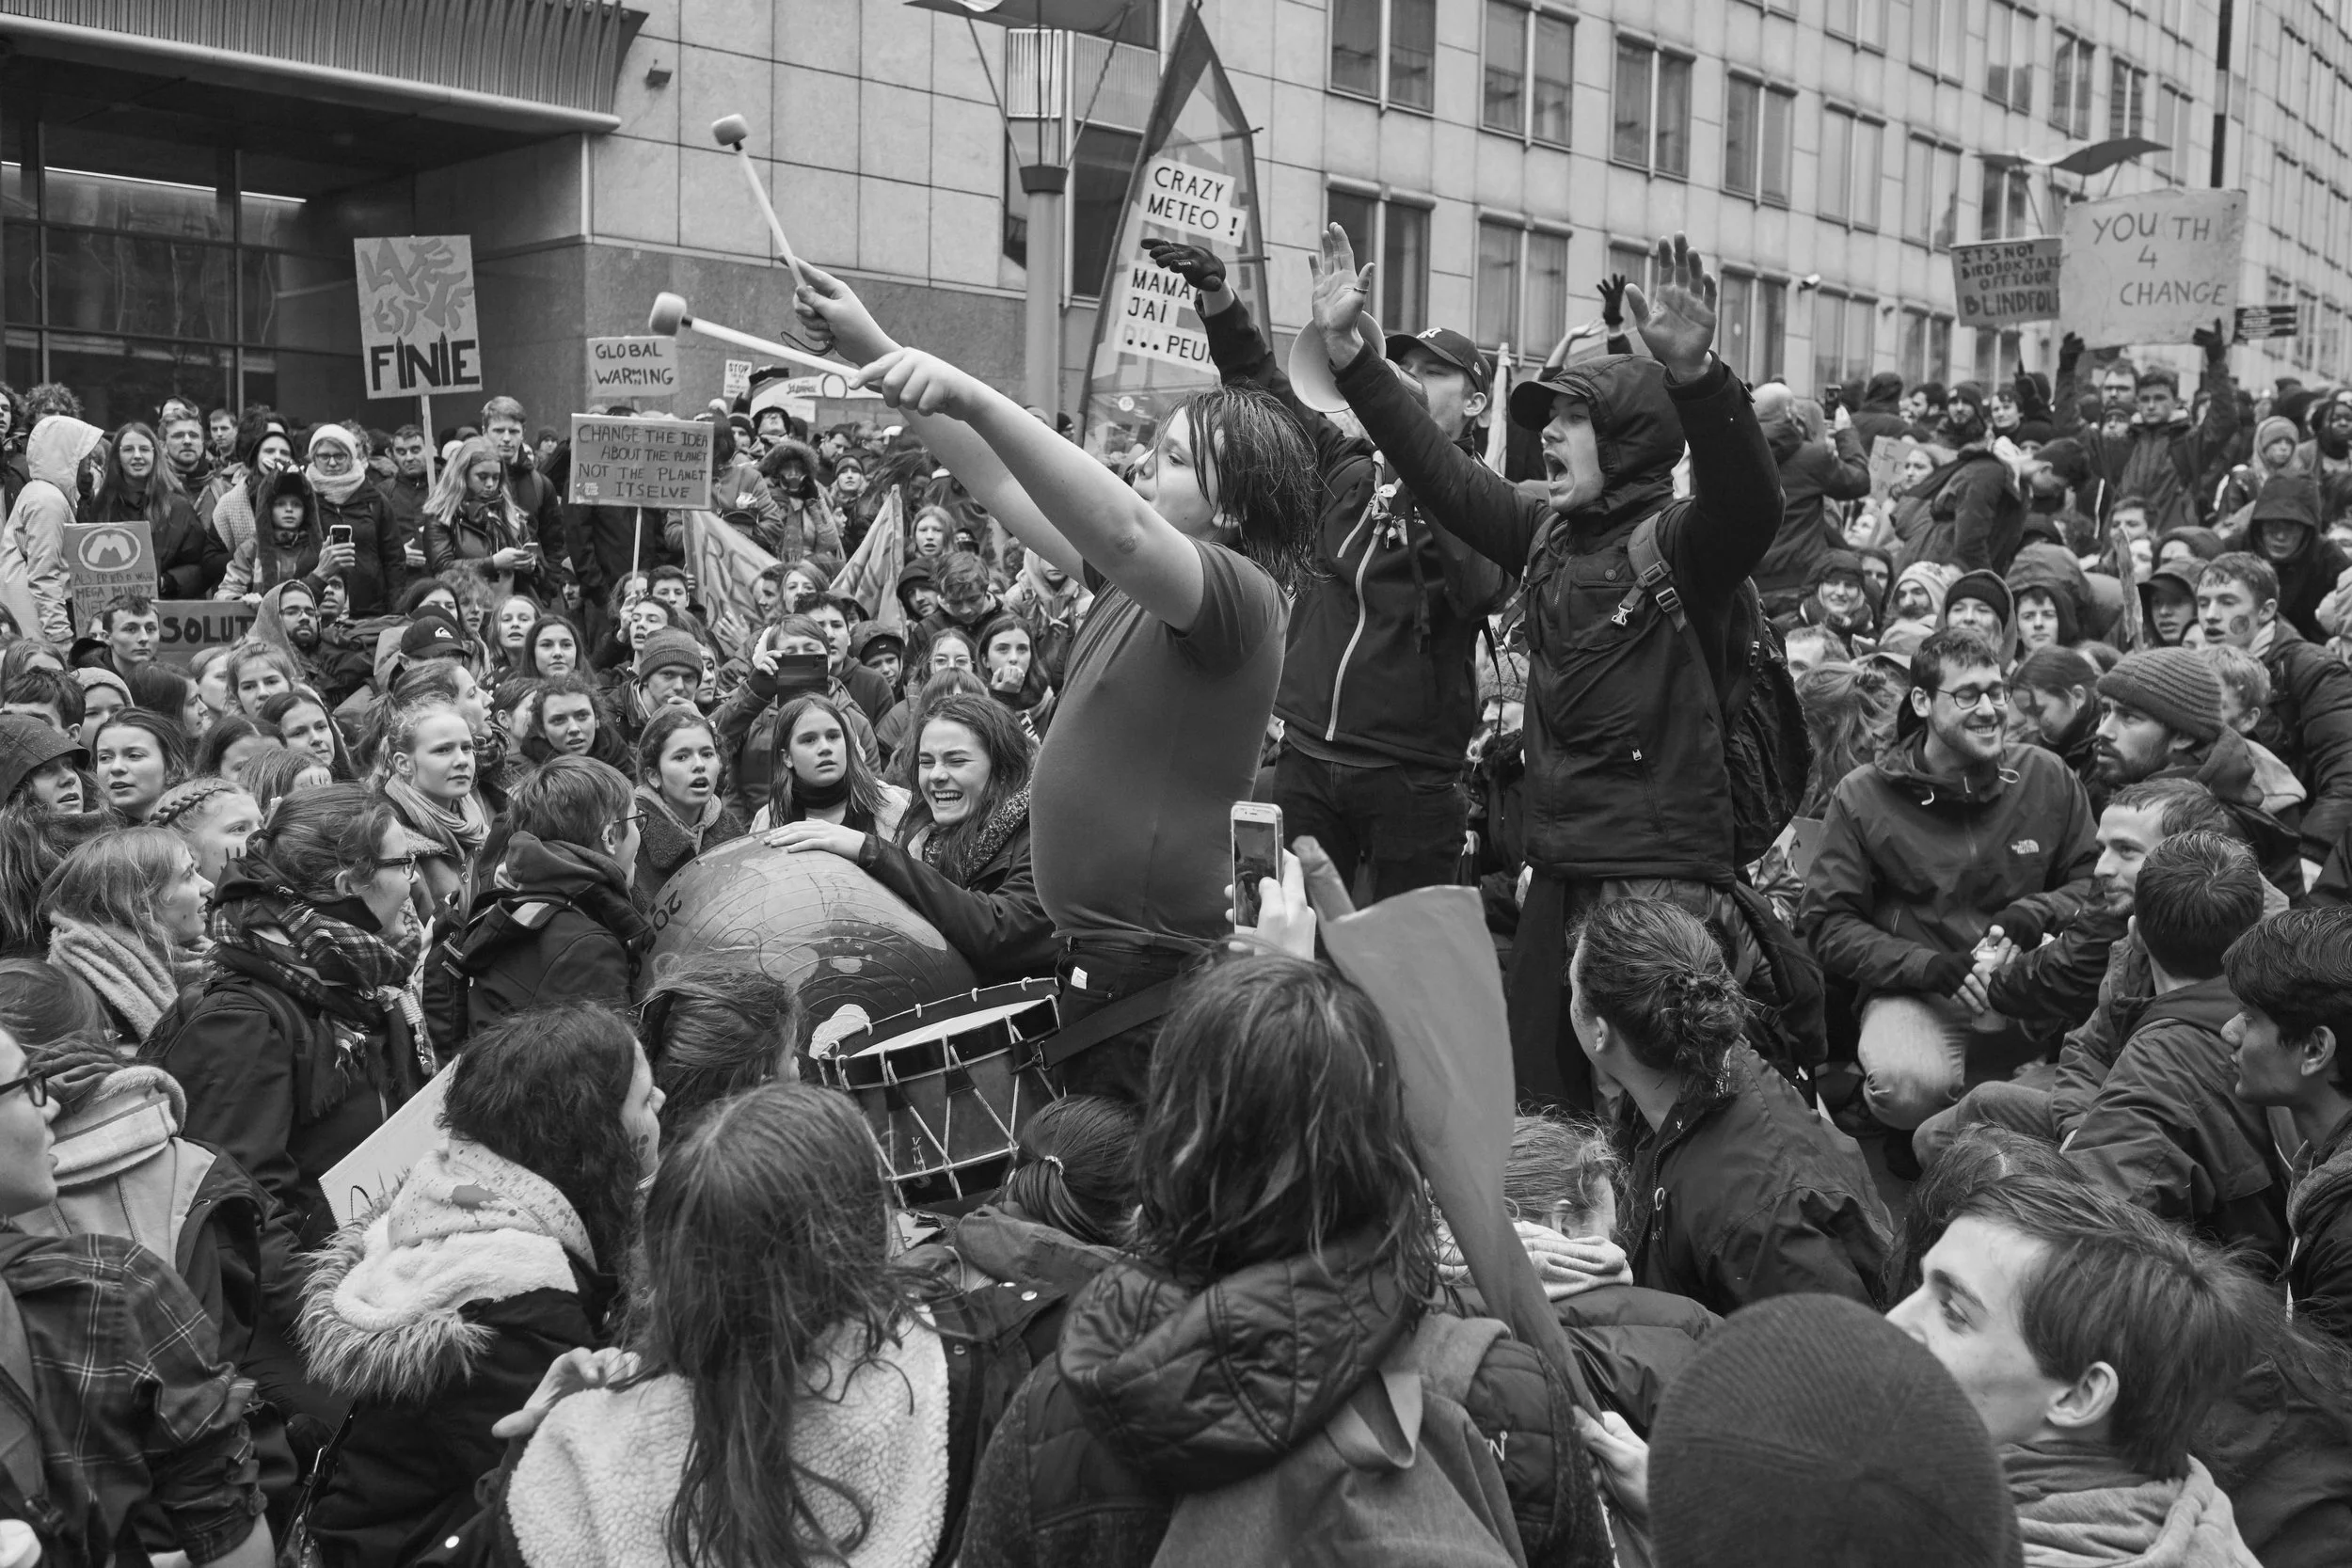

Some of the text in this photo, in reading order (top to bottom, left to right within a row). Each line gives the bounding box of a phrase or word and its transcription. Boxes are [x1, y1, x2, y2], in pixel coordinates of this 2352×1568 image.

[1154, 166, 1224, 202] CRAZY
[2004, 244, 2034, 258] NOT
[2137, 245, 2158, 269] 4
[1132, 268, 1200, 301] MAMA
[2120, 282, 2228, 307] CHANGE
[371, 331, 481, 391] FINIE
[595, 342, 663, 359] GLOBAL
[1166, 335, 1212, 364] PEU
[578, 424, 708, 447] CHANGE THE IDEA
[600, 445, 707, 463] ABOUT THE PLANET
[578, 463, 707, 482] NOT THE PLANET
[614, 481, 691, 499] ITSELVE
[75, 586, 105, 600] MEGA
